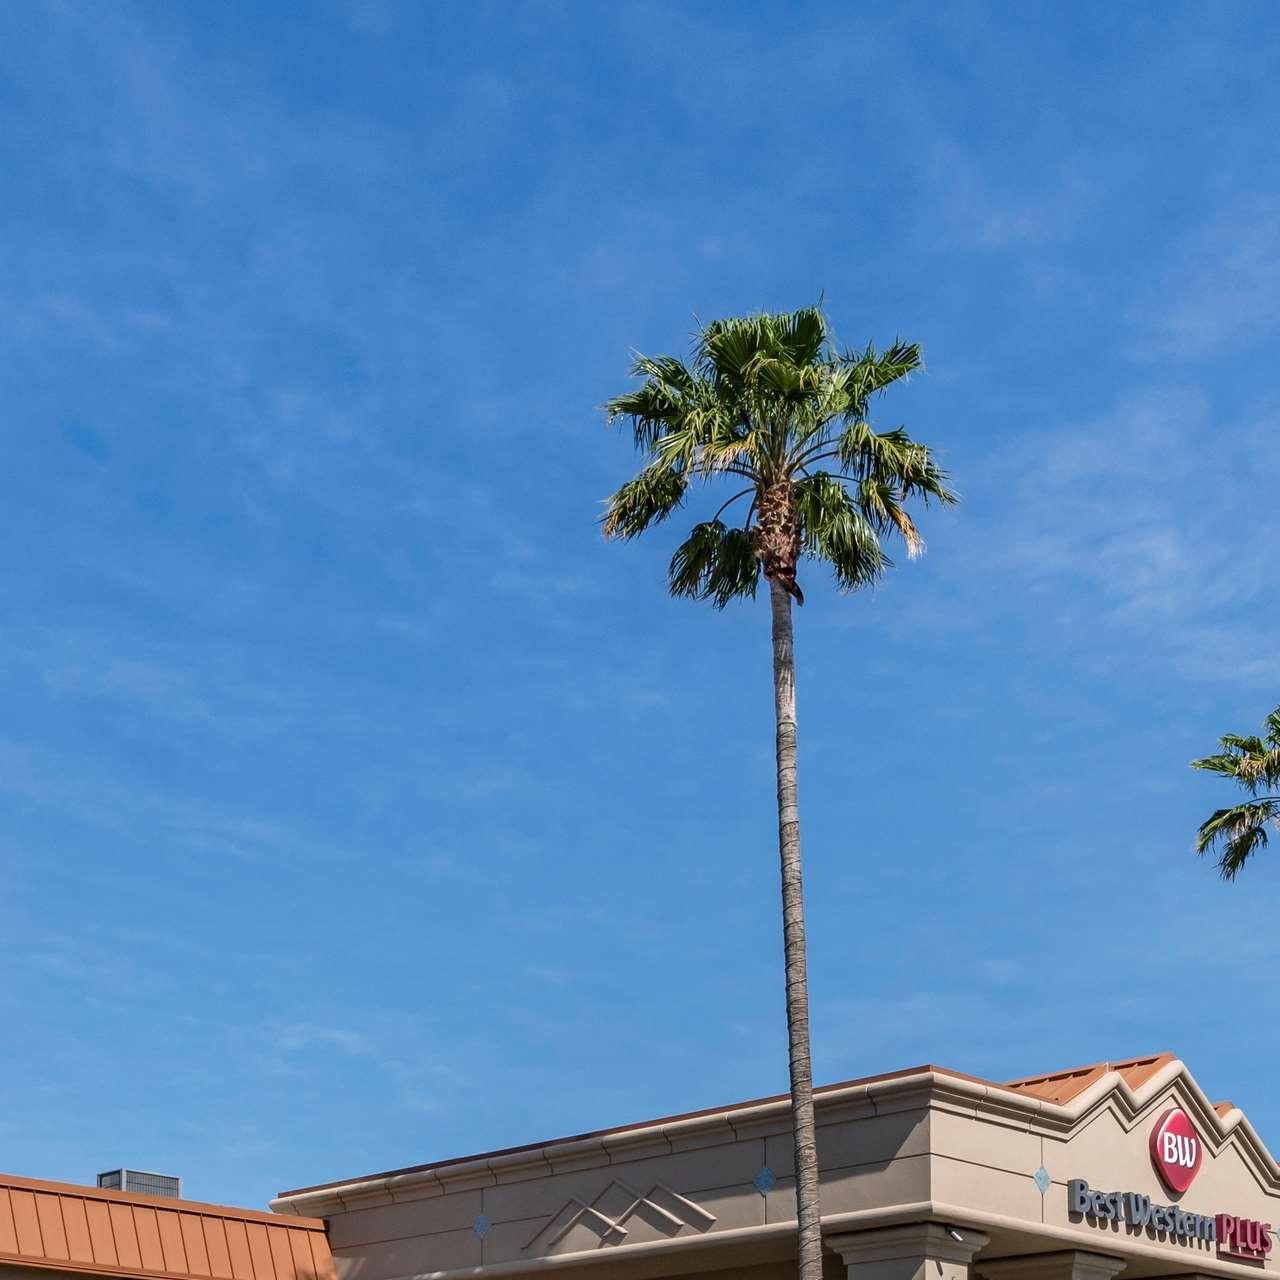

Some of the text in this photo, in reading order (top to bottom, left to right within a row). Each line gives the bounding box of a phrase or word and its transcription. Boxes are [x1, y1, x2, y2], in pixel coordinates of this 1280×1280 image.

[1163, 1132, 1196, 1168] BW
[1068, 1179, 1273, 1253] Best Western PLUS
